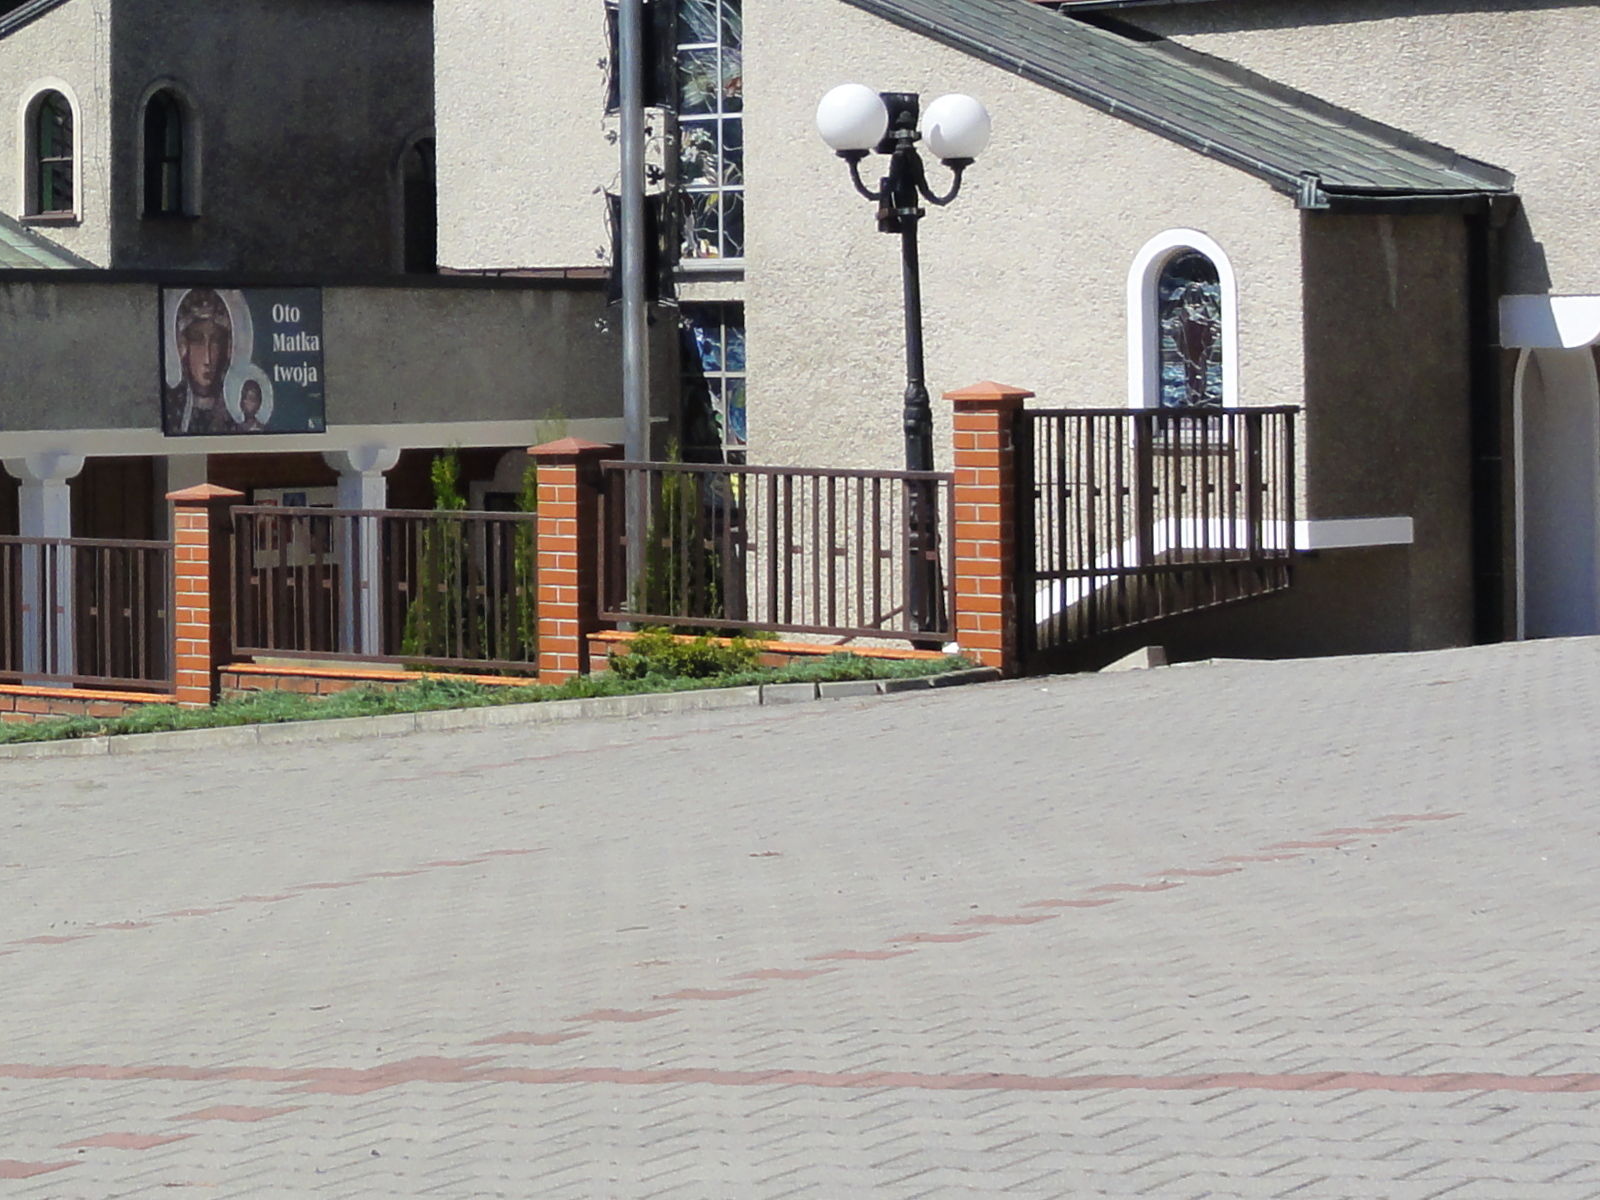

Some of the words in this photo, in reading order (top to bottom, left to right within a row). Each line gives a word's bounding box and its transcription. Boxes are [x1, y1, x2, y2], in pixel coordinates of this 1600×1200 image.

[272, 303, 300, 323] Oto
[272, 331, 320, 352] Matka
[273, 361, 318, 387] twoja
